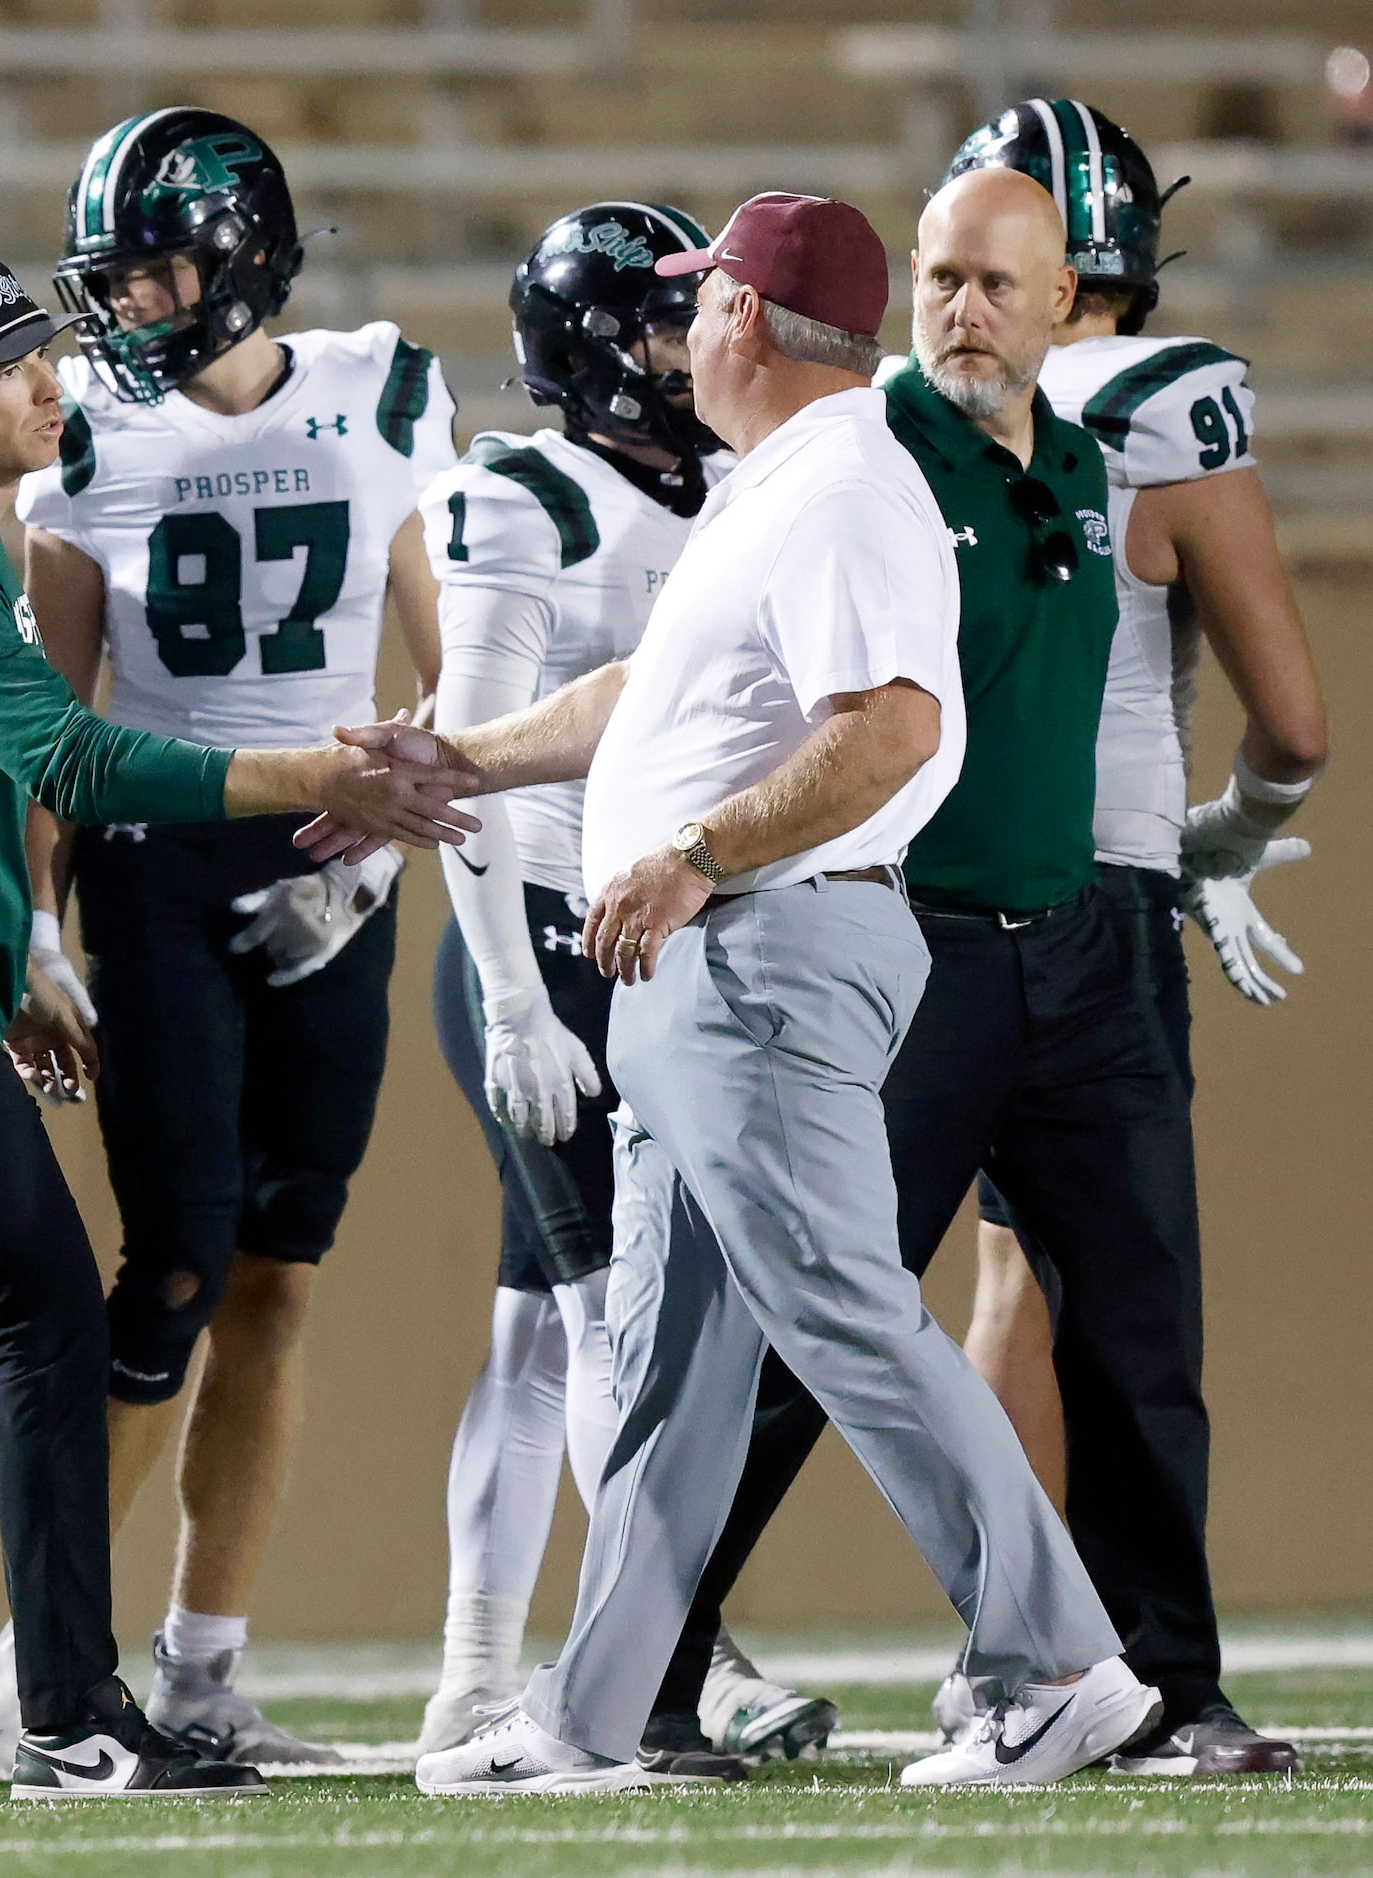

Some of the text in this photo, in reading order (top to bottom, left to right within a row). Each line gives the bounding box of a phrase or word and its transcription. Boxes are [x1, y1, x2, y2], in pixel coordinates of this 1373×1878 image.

[1189, 384, 1248, 471] 91
[176, 469, 310, 501] PROSPER
[447, 491, 470, 562] 1
[145, 500, 350, 679] 87
